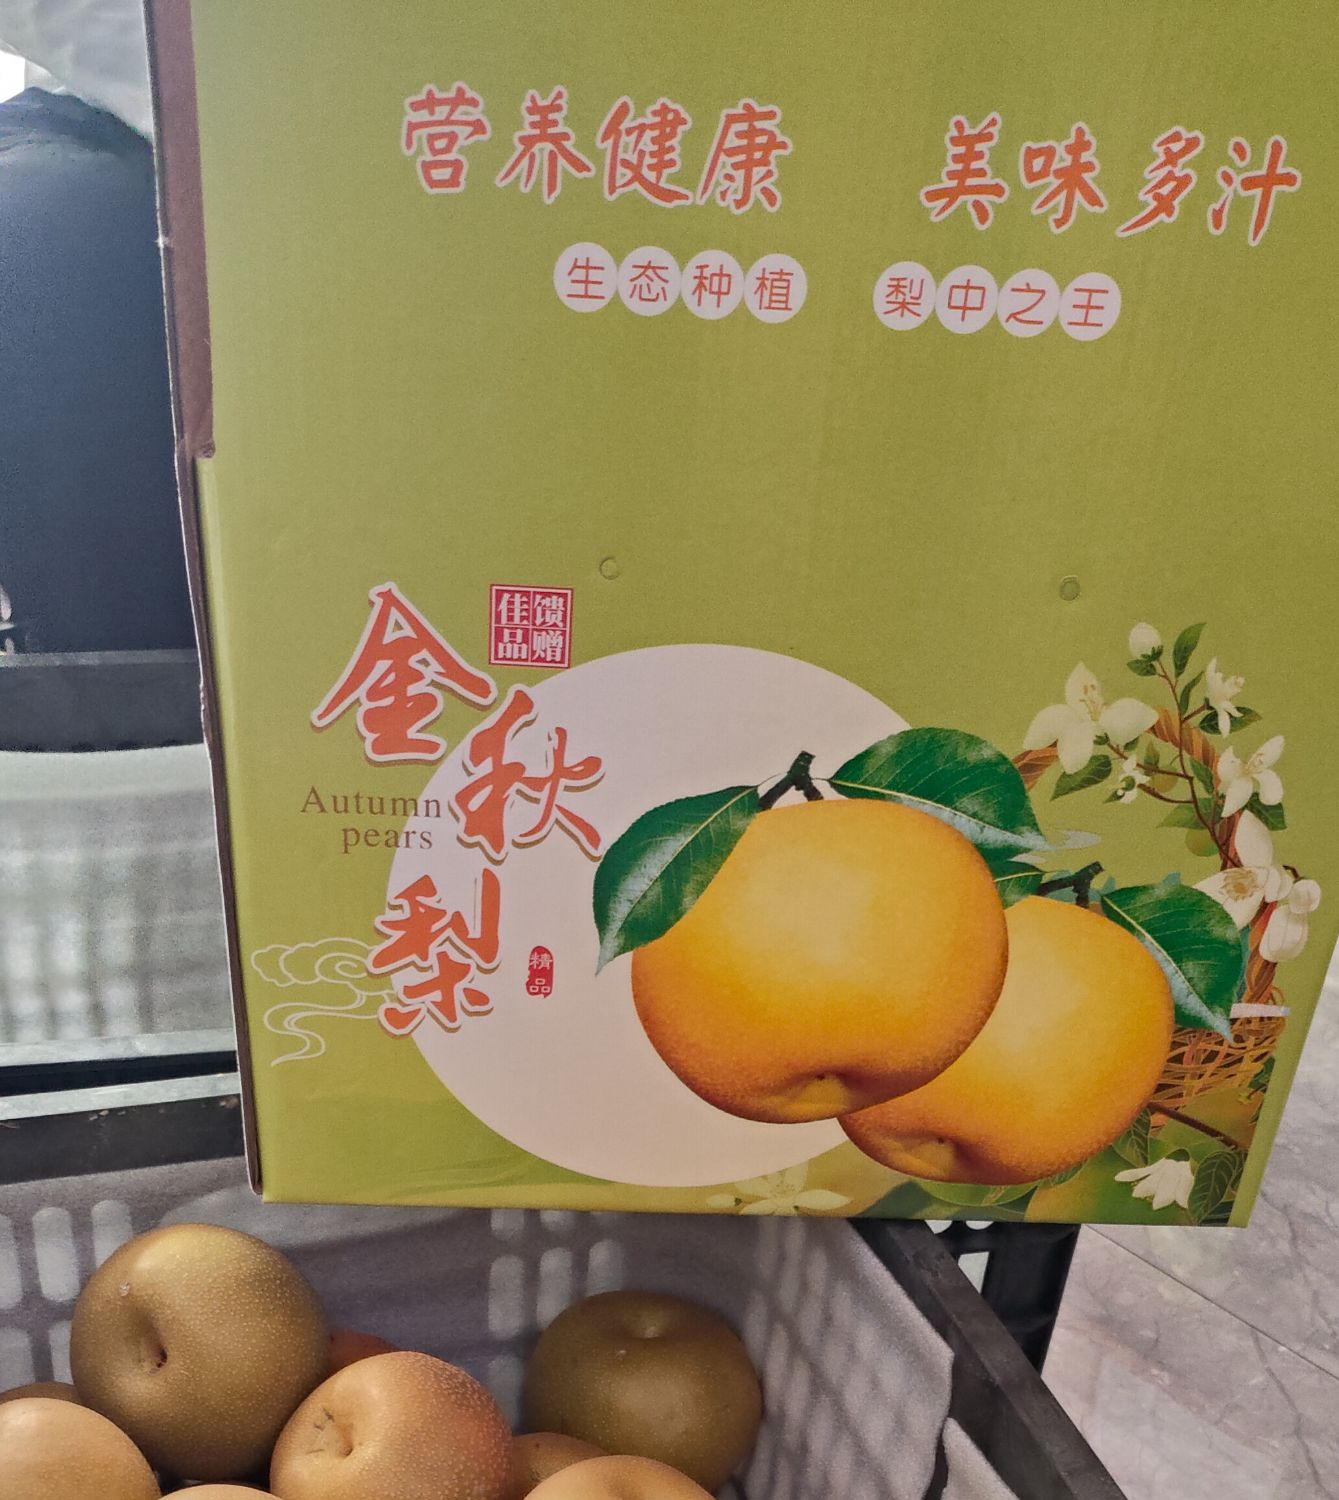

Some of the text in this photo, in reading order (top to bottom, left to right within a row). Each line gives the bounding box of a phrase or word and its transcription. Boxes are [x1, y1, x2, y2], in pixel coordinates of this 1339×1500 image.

[404, 84, 793, 212] 营养健康
[921, 114, 1302, 245] 美味多汁
[565, 254, 798, 314] 生态种植
[883, 278, 1112, 331] 梨中之王
[300, 786, 442, 819] Autumn
[342, 828, 434, 855] pears
